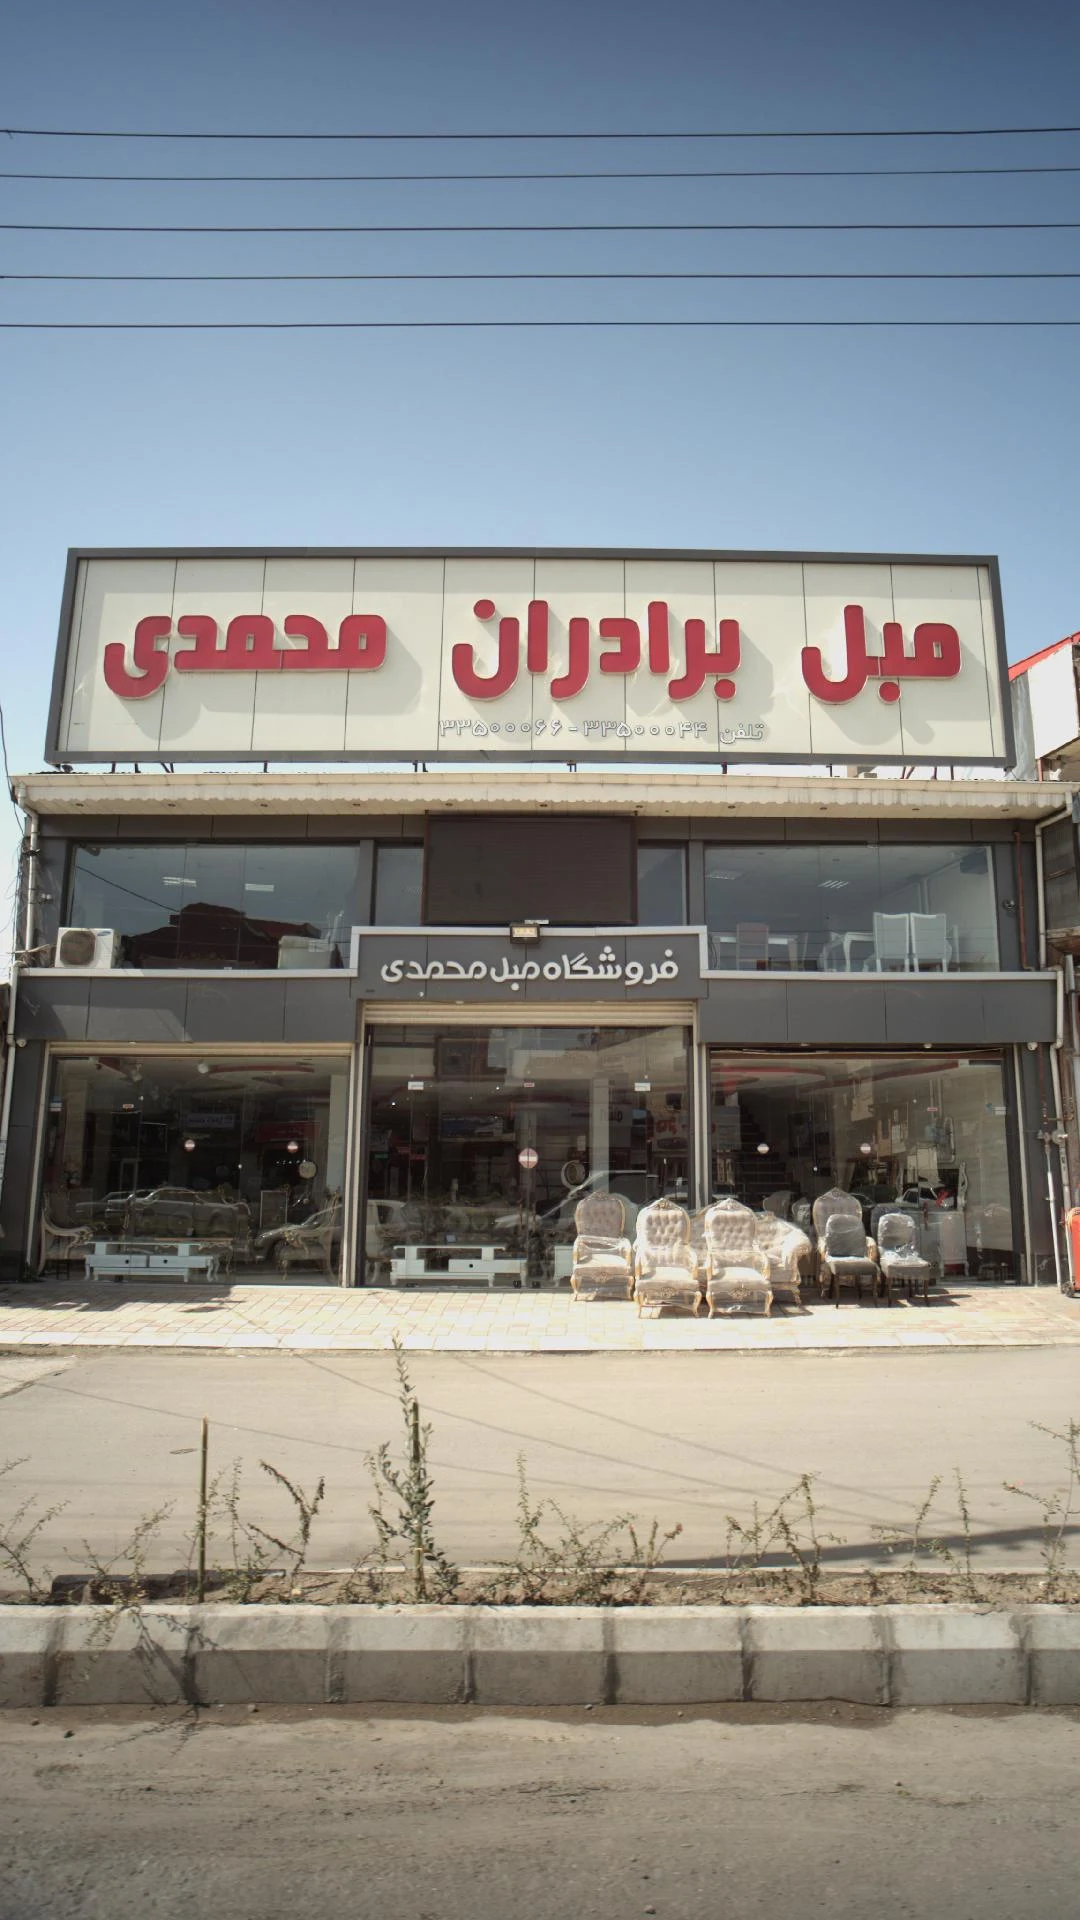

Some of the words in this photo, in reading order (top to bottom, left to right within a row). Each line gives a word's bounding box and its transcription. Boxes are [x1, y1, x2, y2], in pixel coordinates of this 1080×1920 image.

[104, 614, 388, 699] محمدی
[452, 599, 741, 700] برادران
[801, 605, 961, 703] مبل
[720, 721, 765, 744] تلفن
[380, 959, 488, 983] محمدی
[489, 956, 541, 991] مبل
[543, 946, 679, 986] فروشگاه
